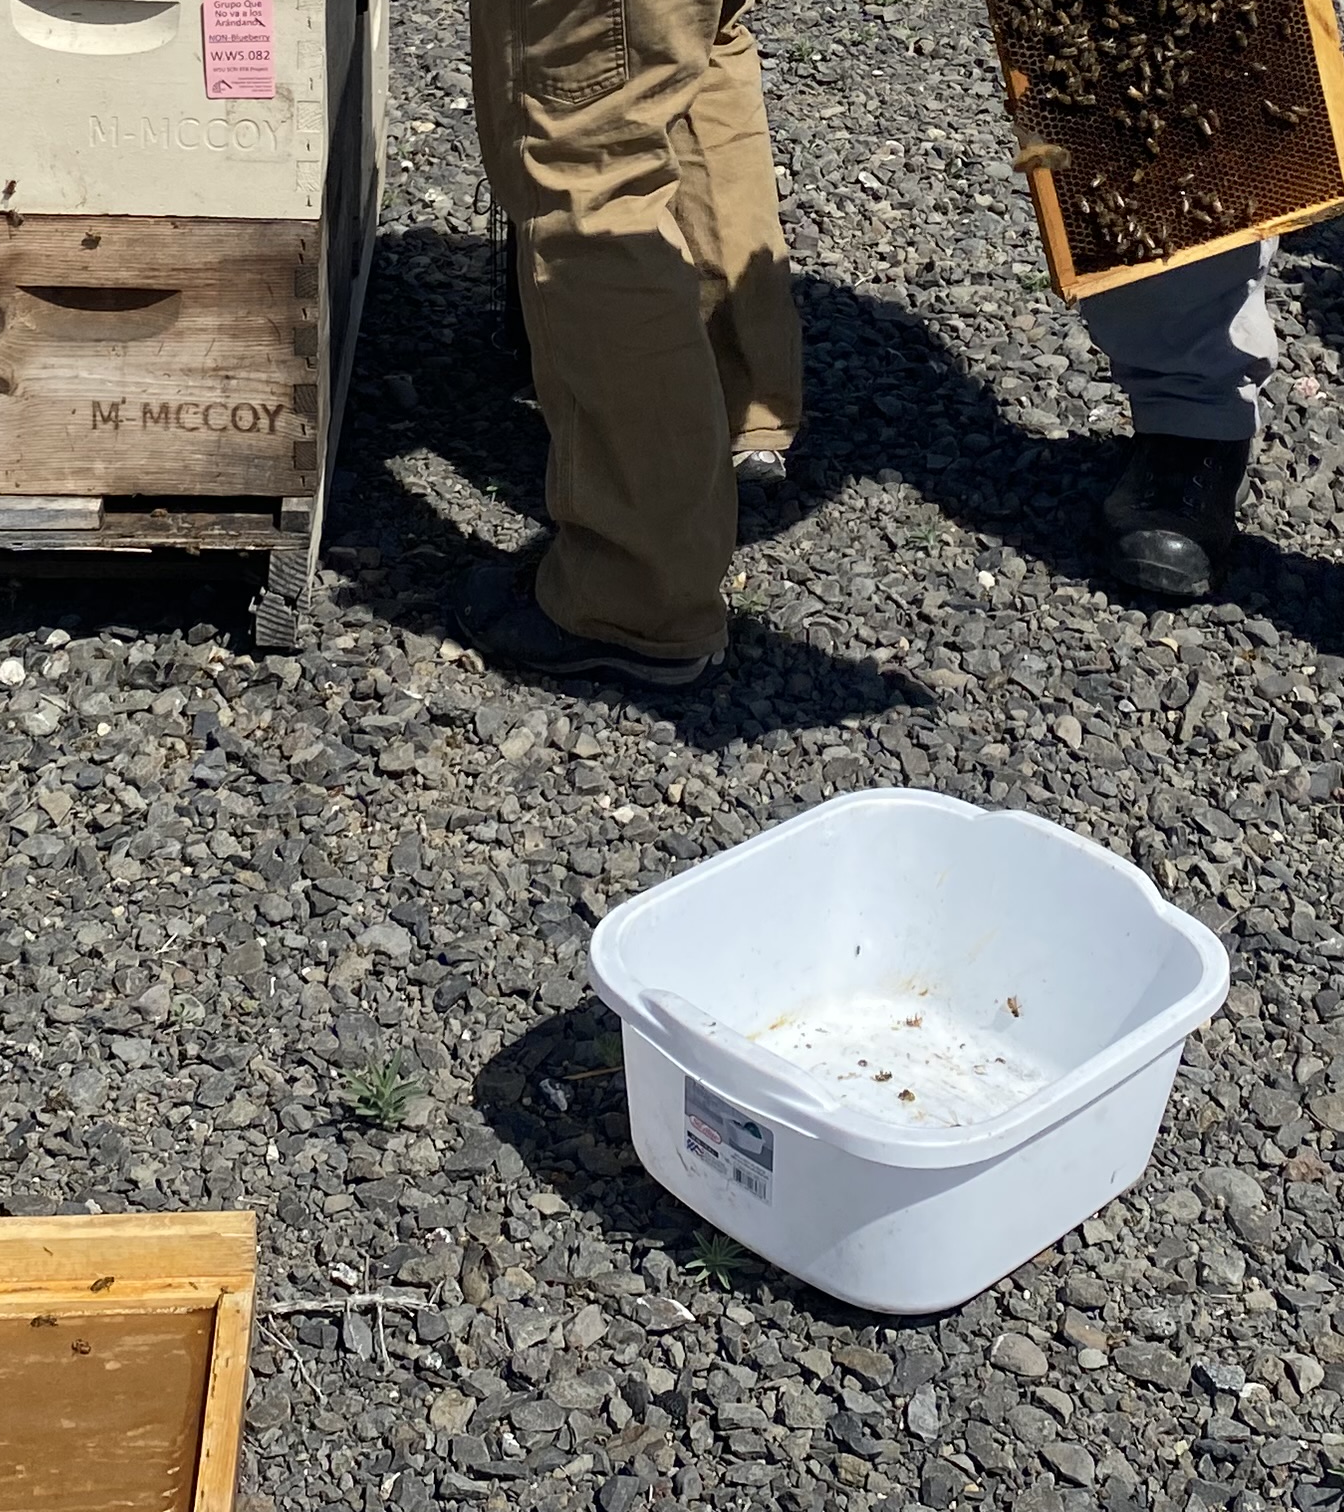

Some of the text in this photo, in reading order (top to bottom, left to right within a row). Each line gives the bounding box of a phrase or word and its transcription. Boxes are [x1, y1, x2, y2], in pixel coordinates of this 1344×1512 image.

[213, 0, 263, 10] Grupo Que
[214, 10, 228, 18] No
[249, 9, 263, 17] los
[214, 18, 264, 27] Arándano
[208, 33, 271, 43] NON-Blueberry
[210, 50, 271, 61] W.WS.082
[89, 114, 286, 153] M-MCCOY
[91, 399, 286, 435] M-MCCOY
